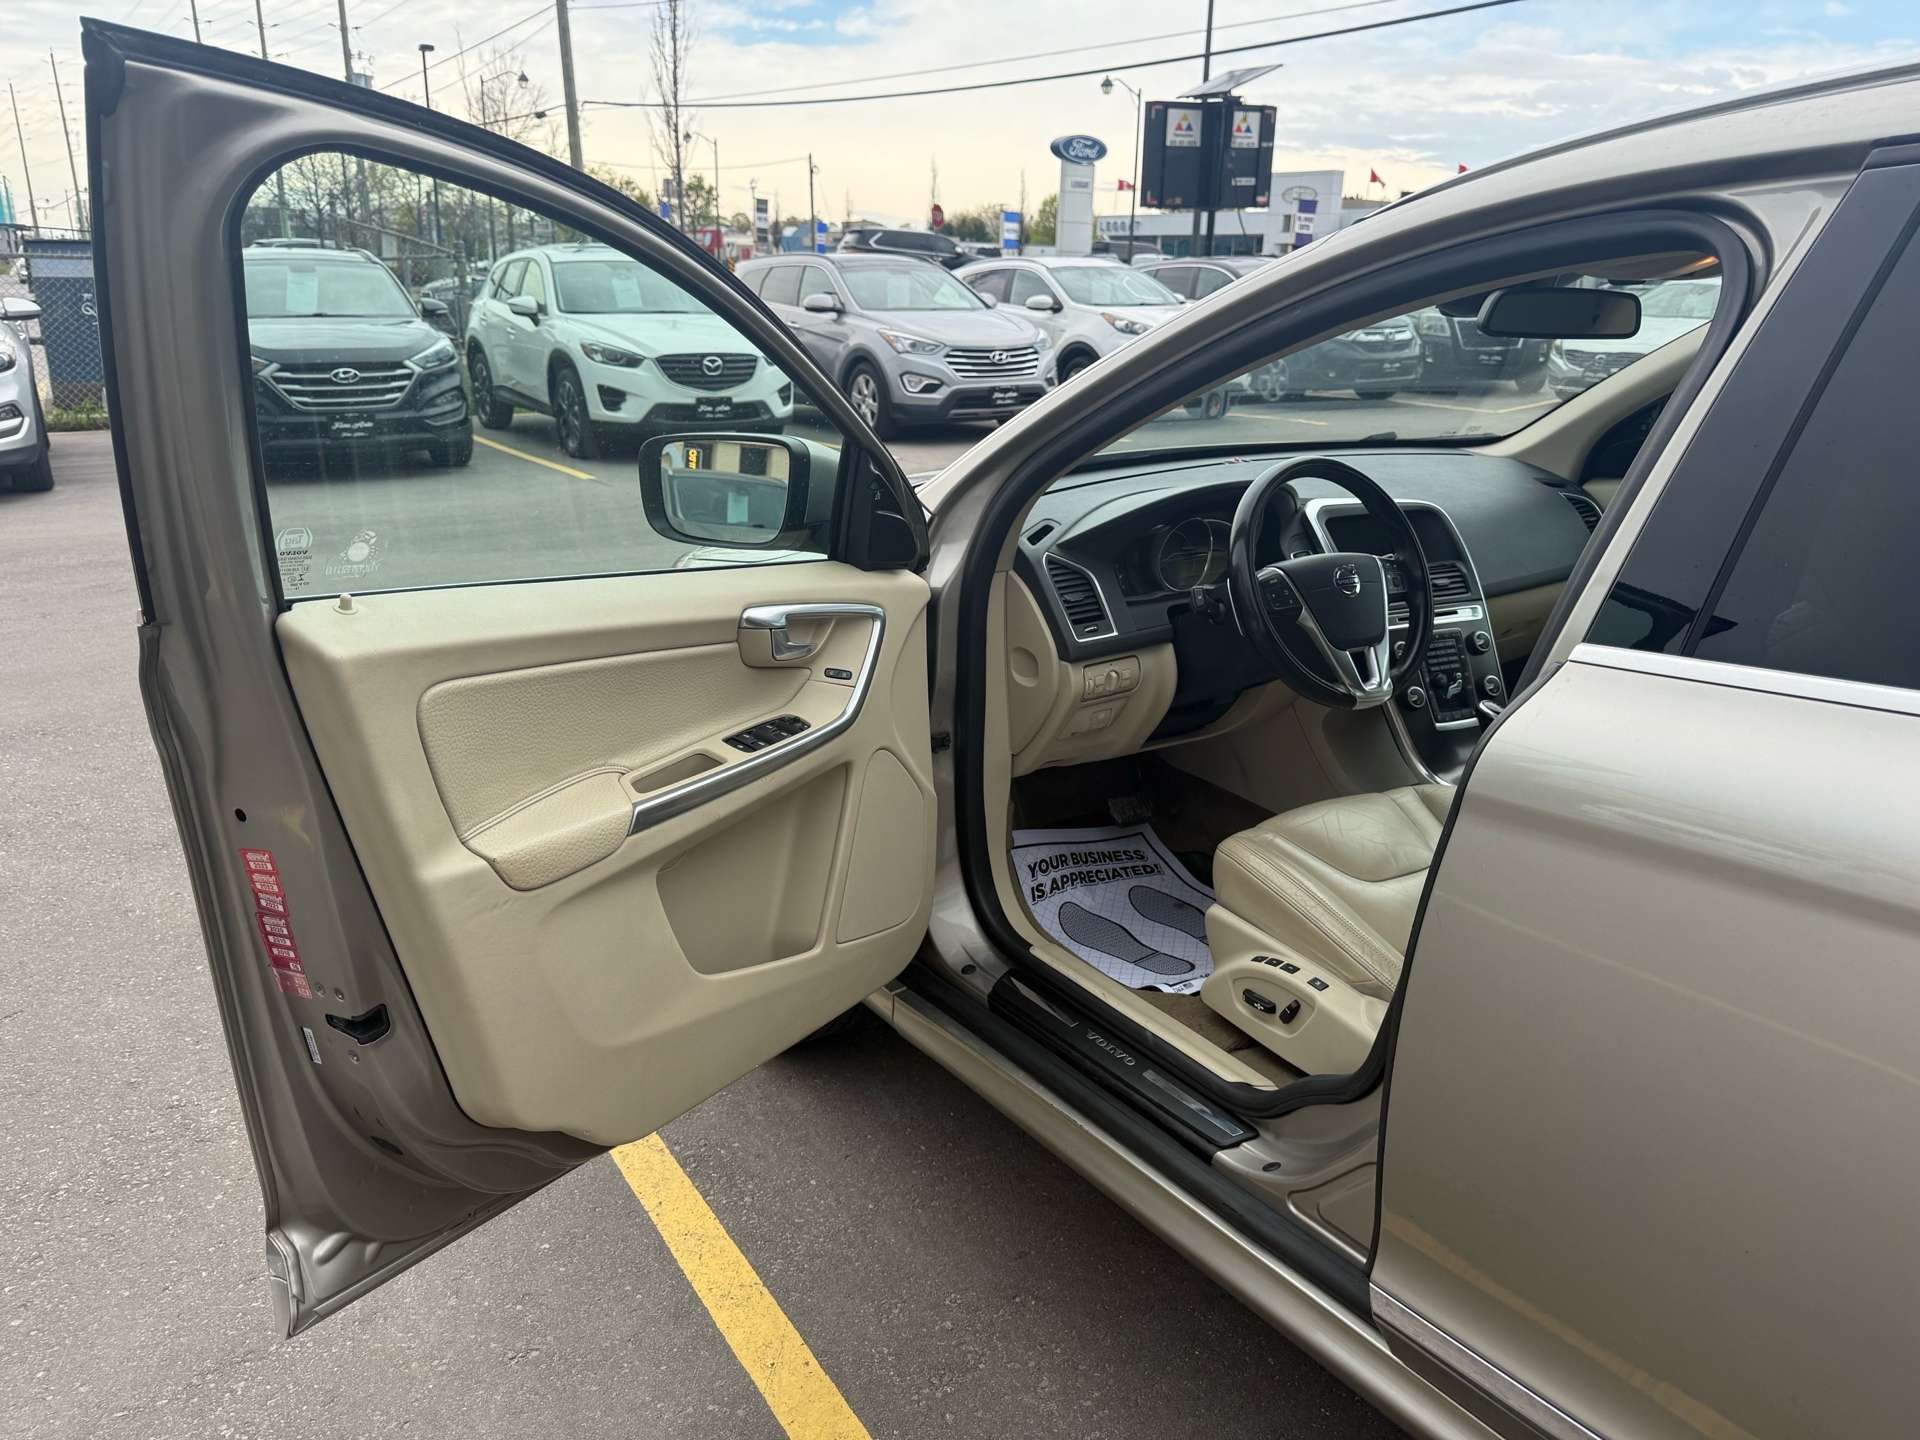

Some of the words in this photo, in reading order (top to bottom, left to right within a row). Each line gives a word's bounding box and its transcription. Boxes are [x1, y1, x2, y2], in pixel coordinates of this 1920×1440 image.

[1069, 139, 1099, 158] Ford
[1027, 853, 1069, 879] YOUR
[1071, 849, 1147, 867] BUSINESS
[1030, 885, 1046, 902] IS
[1048, 863, 1162, 893] APPRECIATED!
[1086, 1029, 1136, 1066] VOLVO
